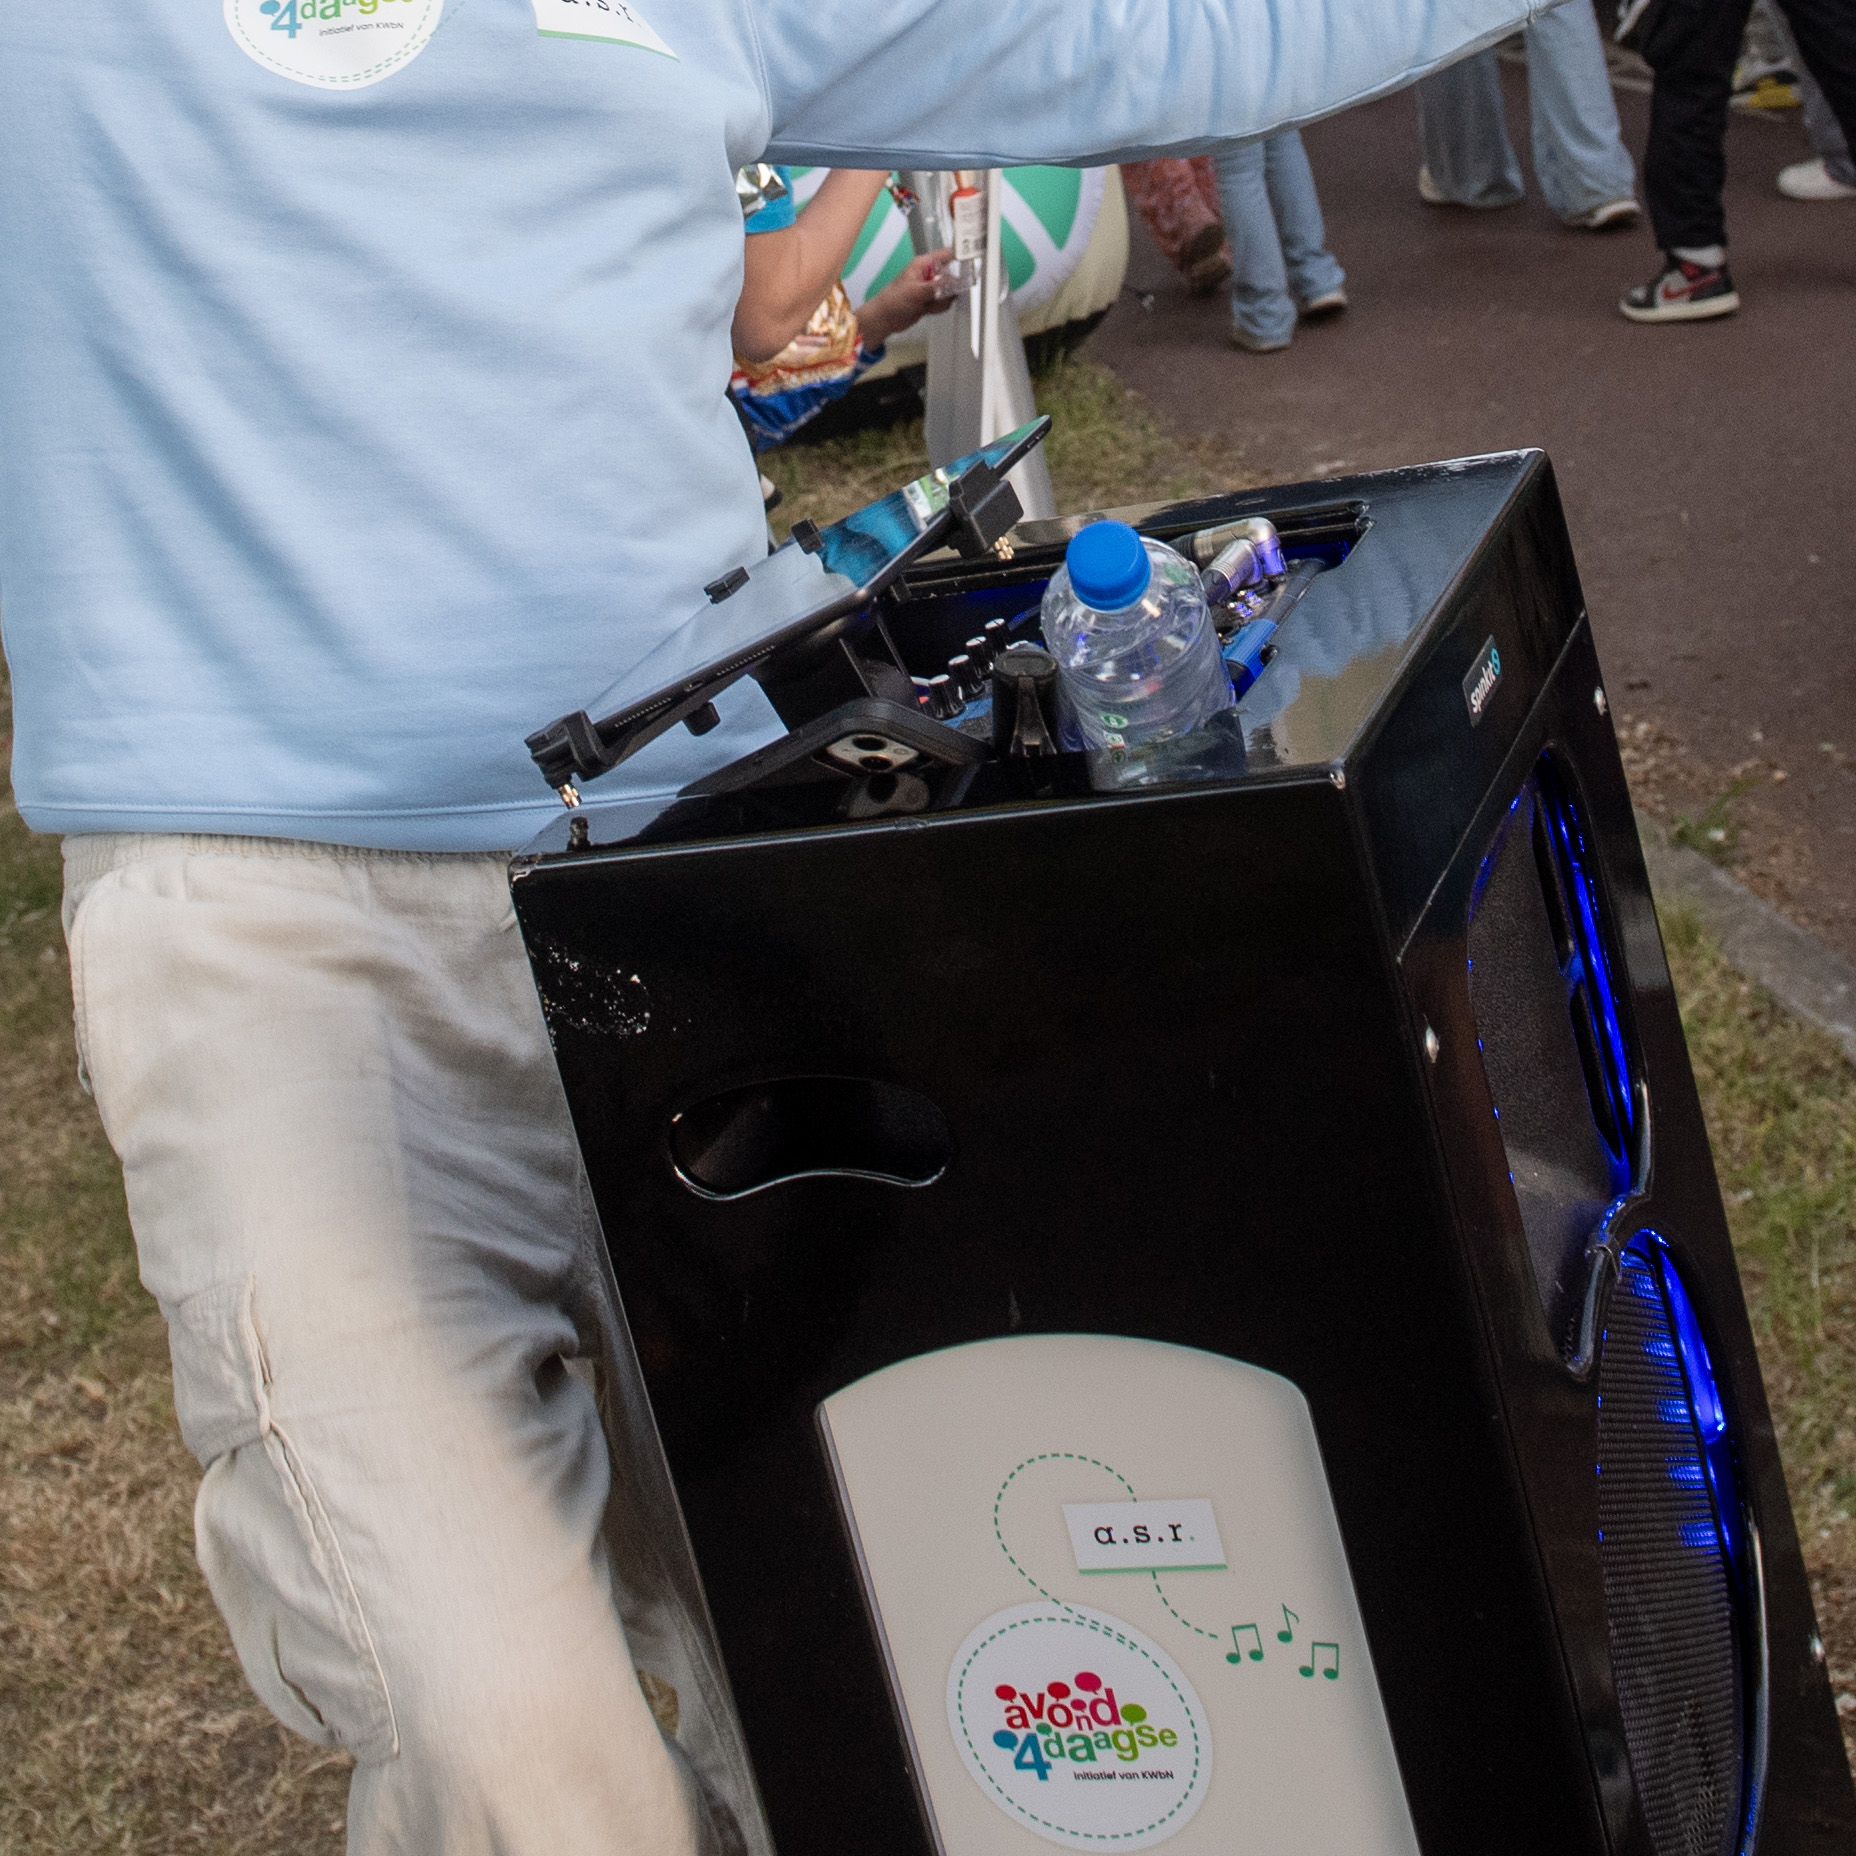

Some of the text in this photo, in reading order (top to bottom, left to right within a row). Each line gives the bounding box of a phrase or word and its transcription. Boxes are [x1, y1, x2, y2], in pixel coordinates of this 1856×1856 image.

[319, 24, 355, 36] initiatief
[356, 22, 374, 30] van
[1004, 1687, 1122, 1731] avond
[1013, 1724, 1179, 1782] 4daagse
[1073, 1770, 1174, 1781] initiatief van KWbN
